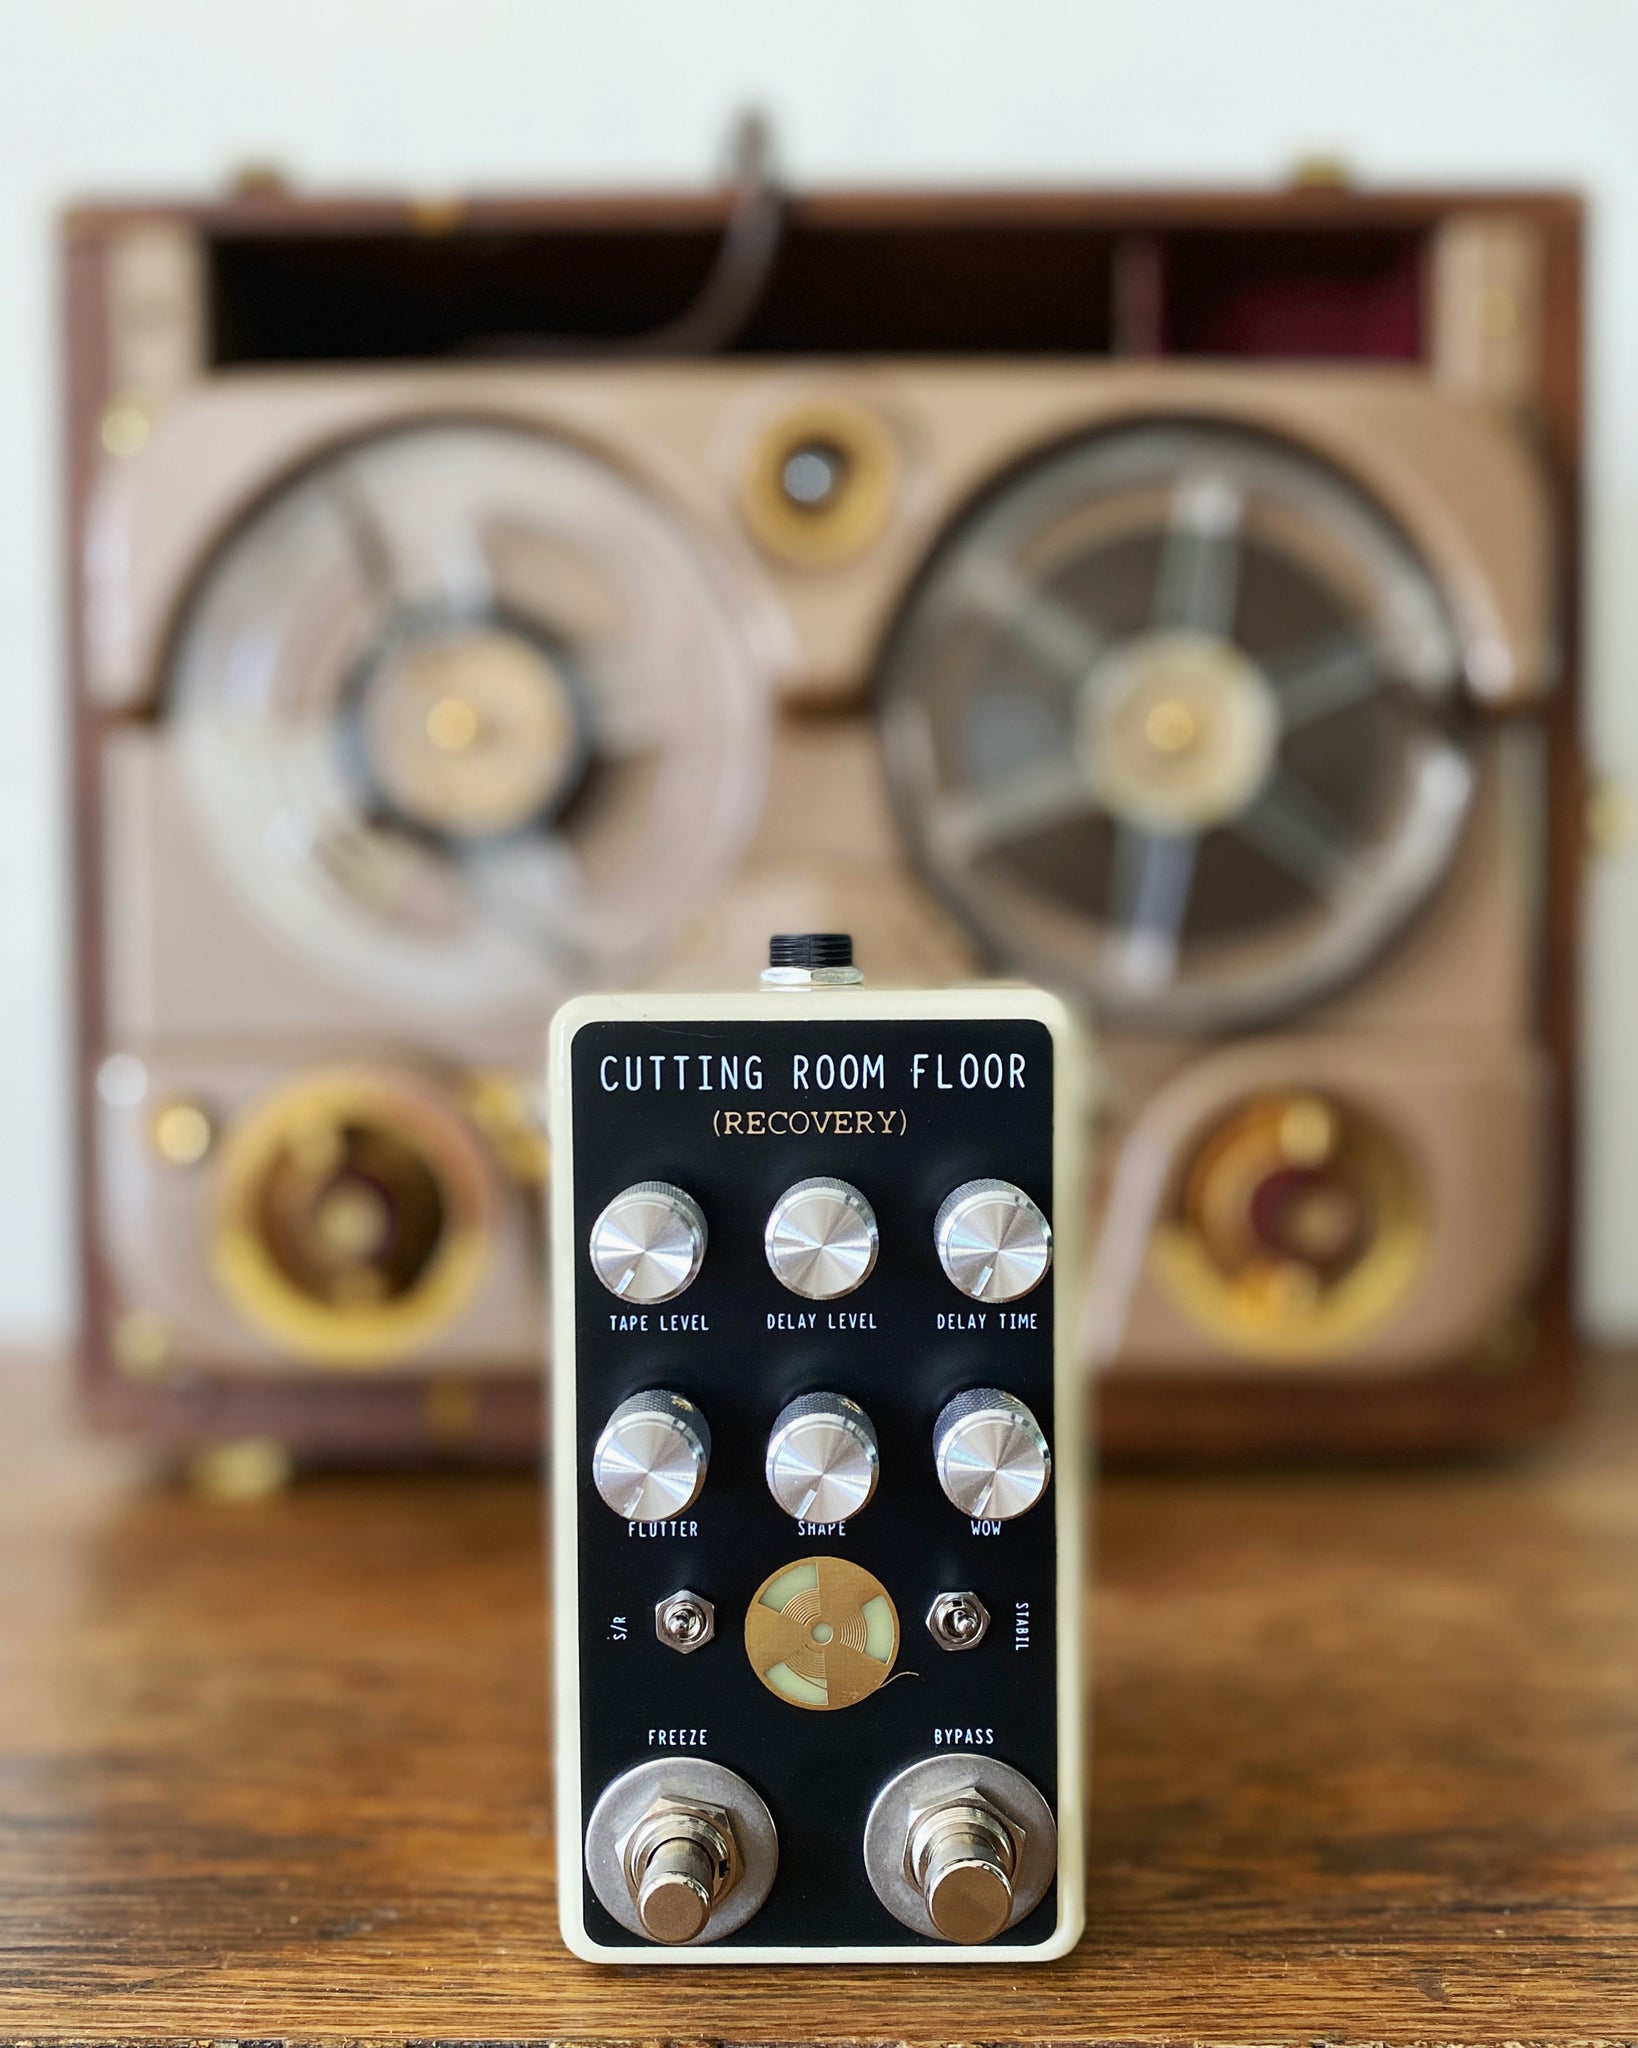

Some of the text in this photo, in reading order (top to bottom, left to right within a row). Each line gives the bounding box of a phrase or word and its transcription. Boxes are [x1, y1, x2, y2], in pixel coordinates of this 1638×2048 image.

[600, 1052, 1026, 1092] CUTTING ROOM FLOOR
[713, 1108, 907, 1137] (RECOVERY)
[609, 1314, 710, 1332] TAPE LEVEL
[766, 1312, 877, 1330] DELAY LEVEL
[936, 1312, 1038, 1330] DELAY TIME
[627, 1519, 698, 1538] FLUTTER
[797, 1519, 846, 1537] SHAPE
[970, 1519, 1002, 1537] WOW
[610, 1616, 628, 1641] S/R
[1015, 1602, 1030, 1651] STABIL
[648, 1728, 708, 1746] FREEZE
[934, 1728, 994, 1745] BYPASS
